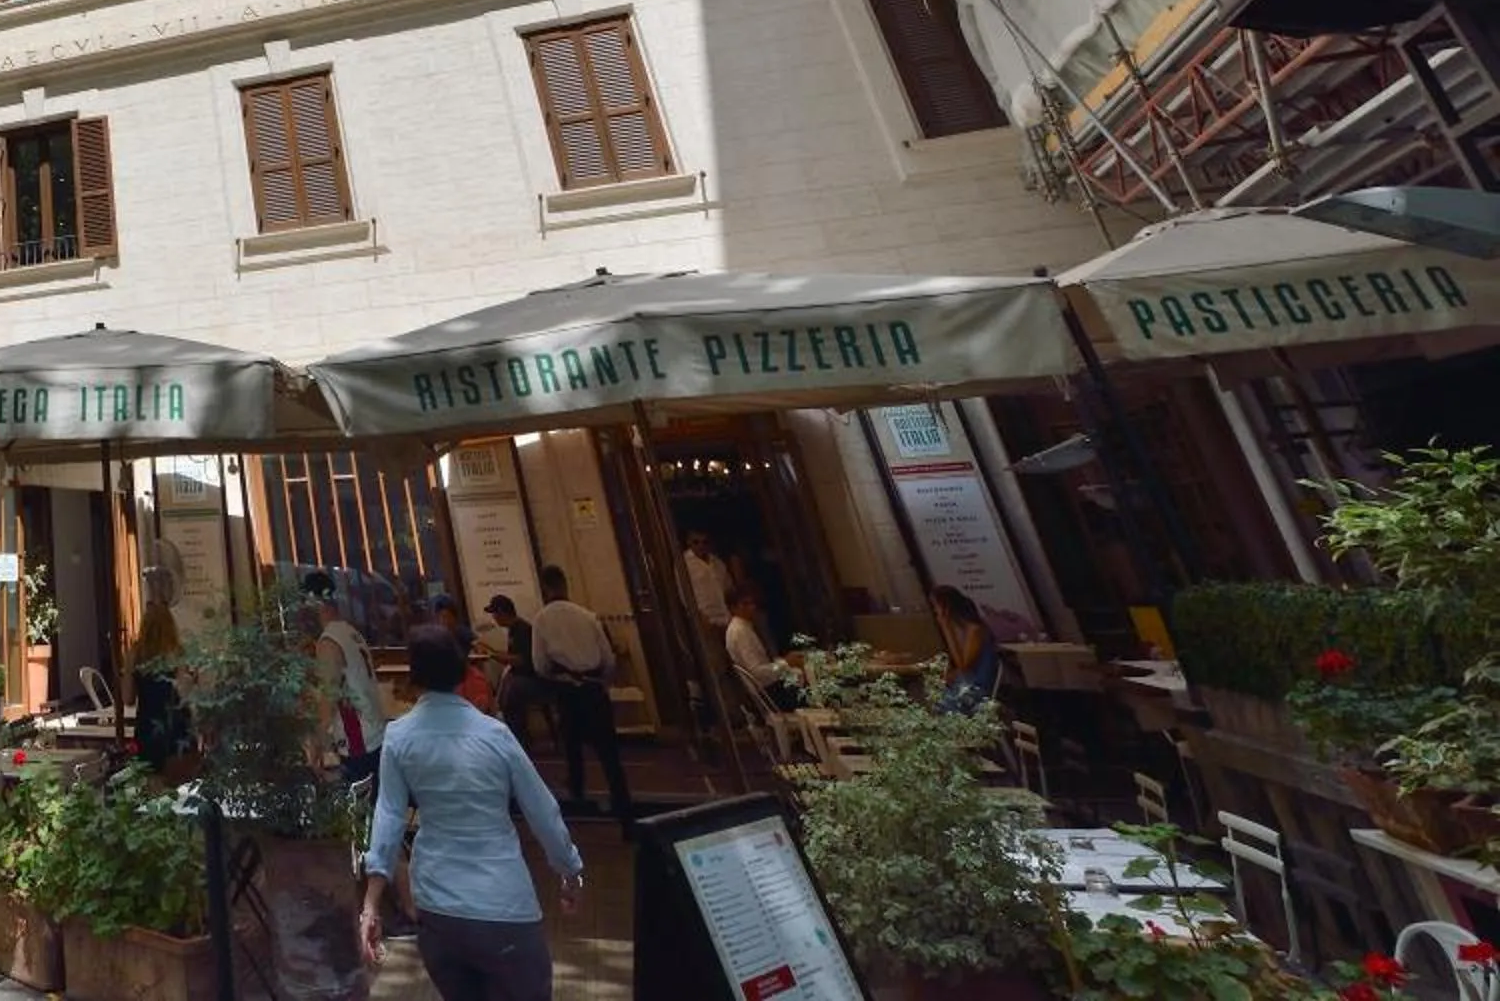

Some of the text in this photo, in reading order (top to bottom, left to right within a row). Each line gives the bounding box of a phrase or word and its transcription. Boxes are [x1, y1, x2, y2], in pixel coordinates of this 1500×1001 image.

[151, 16, 200, 38] VII
[412, 319, 921, 410] RISTORANTE PIZZERIA
[80, 382, 186, 421] ITALIA
